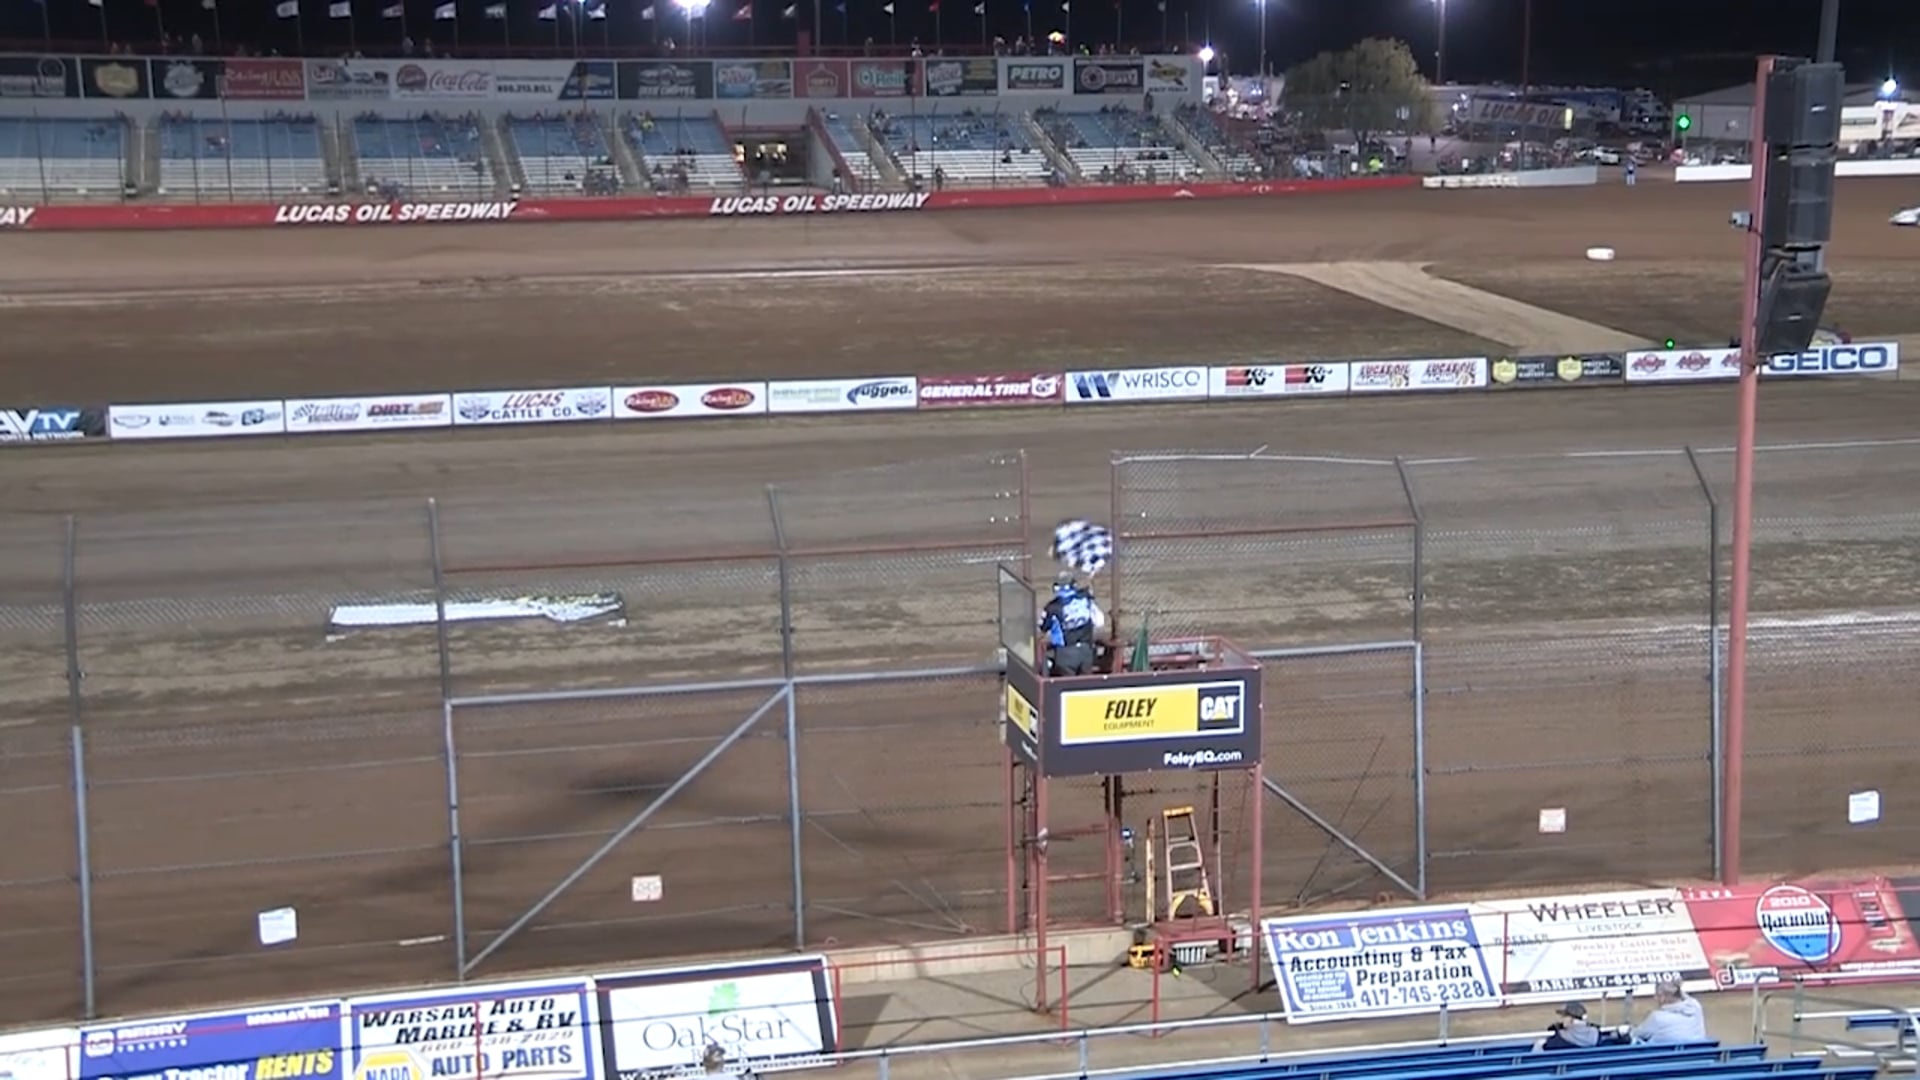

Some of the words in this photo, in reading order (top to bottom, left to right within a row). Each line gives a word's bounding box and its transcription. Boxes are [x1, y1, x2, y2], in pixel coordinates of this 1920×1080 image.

[1011, 66, 1061, 81] PETRO
[275, 204, 352, 222] LUCAS
[356, 203, 393, 221] OIL
[398, 201, 516, 220] SPEEDWAY
[711, 197, 778, 213] LUCAS
[783, 195, 816, 211] OIL
[820, 192, 930, 210] SPEEDWAY
[0, 207, 34, 225] AY
[1770, 346, 1888, 371] GEICO
[1122, 370, 1201, 388] WRISCO
[503, 392, 565, 409] LUCAS
[920, 383, 993, 399] GENERAL
[994, 381, 1031, 397] TIRE
[491, 408, 542, 420] CATTLE
[1105, 697, 1157, 720] FOLEY
[1201, 696, 1239, 721] CAT
[1104, 719, 1155, 731] EQUIPMENT
[1164, 750, 1242, 768] FoleyEQ.com
[1528, 898, 1676, 923] WHEELER
[1346, 919, 1468, 956] Jenkins
[1571, 940, 1615, 952] Weekly
[1620, 938, 1657, 950] Cattle
[1661, 936, 1688, 946] Sale
[1291, 950, 1403, 973] Accounting
[1411, 947, 1423, 962] &
[1430, 944, 1467, 961] Tax
[1576, 956, 1619, 969] Special
[1624, 953, 1661, 965] Cattle
[1665, 951, 1692, 961] Sale
[1356, 965, 1473, 987] Preparation
[1529, 978, 1579, 992] BARN:
[1360, 980, 1486, 1007] 417-745-2328
[363, 1006, 478, 1028] WARSAW
[490, 998, 555, 1016] AUTO
[395, 1019, 500, 1044] MARINE
[507, 1018, 524, 1033] &
[536, 1011, 576, 1030] RV
[642, 1014, 793, 1051] OakStar
[255, 1050, 335, 1080] RENTS
[432, 1053, 490, 1077] AUTO
[502, 1045, 573, 1070] PARTS
